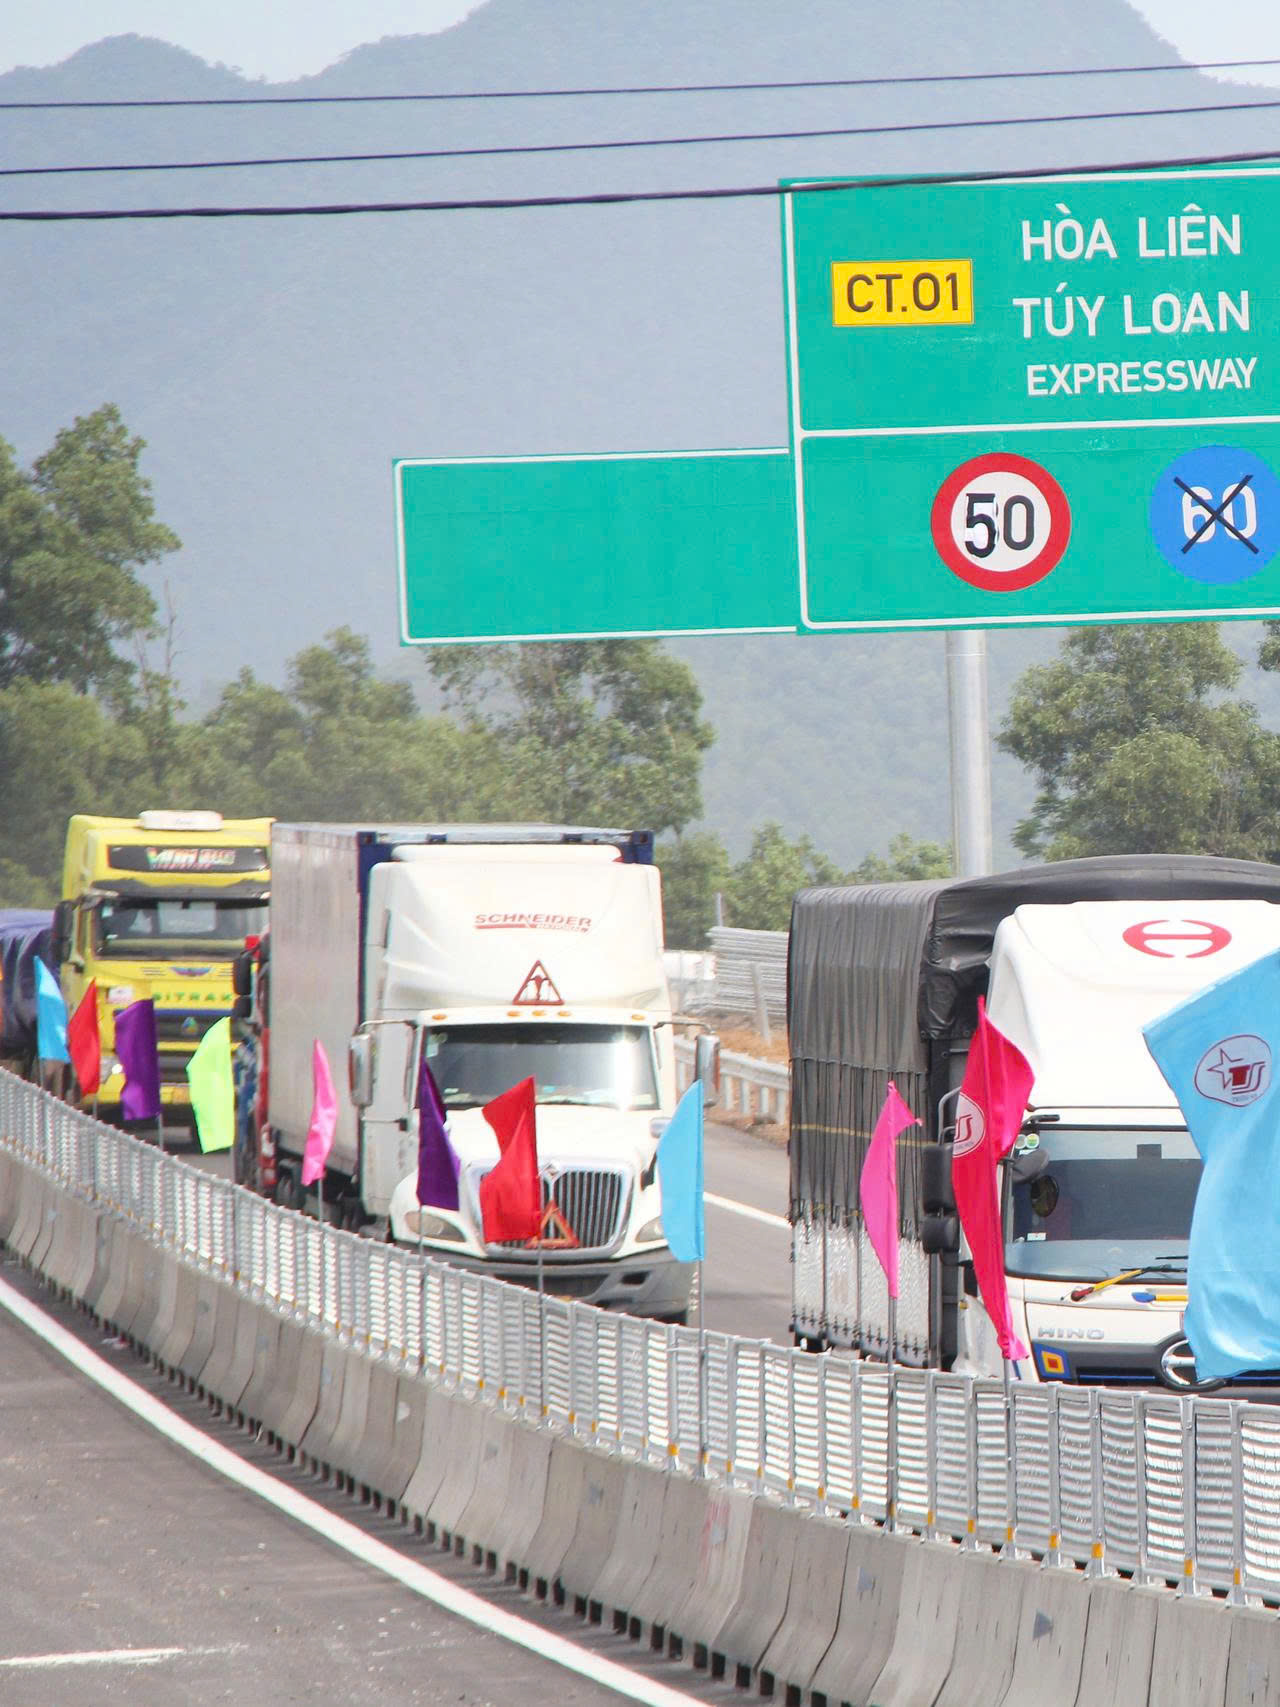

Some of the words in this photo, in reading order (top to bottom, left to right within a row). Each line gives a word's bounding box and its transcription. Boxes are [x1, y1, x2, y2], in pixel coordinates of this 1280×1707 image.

[1022, 203, 1118, 261] HÒA
[1138, 203, 1241, 257] LIÊN
[847, 272, 959, 313] CT.01
[1012, 282, 1105, 339] TÚY
[1123, 290, 1250, 335] LOAN
[1026, 357, 1258, 396] EXPRESSWAY
[964, 493, 1035, 559] 50
[1181, 482, 1257, 543] 60
[475, 913, 592, 927] SCHNEIDER
[1038, 1327, 1104, 1340] HINO
